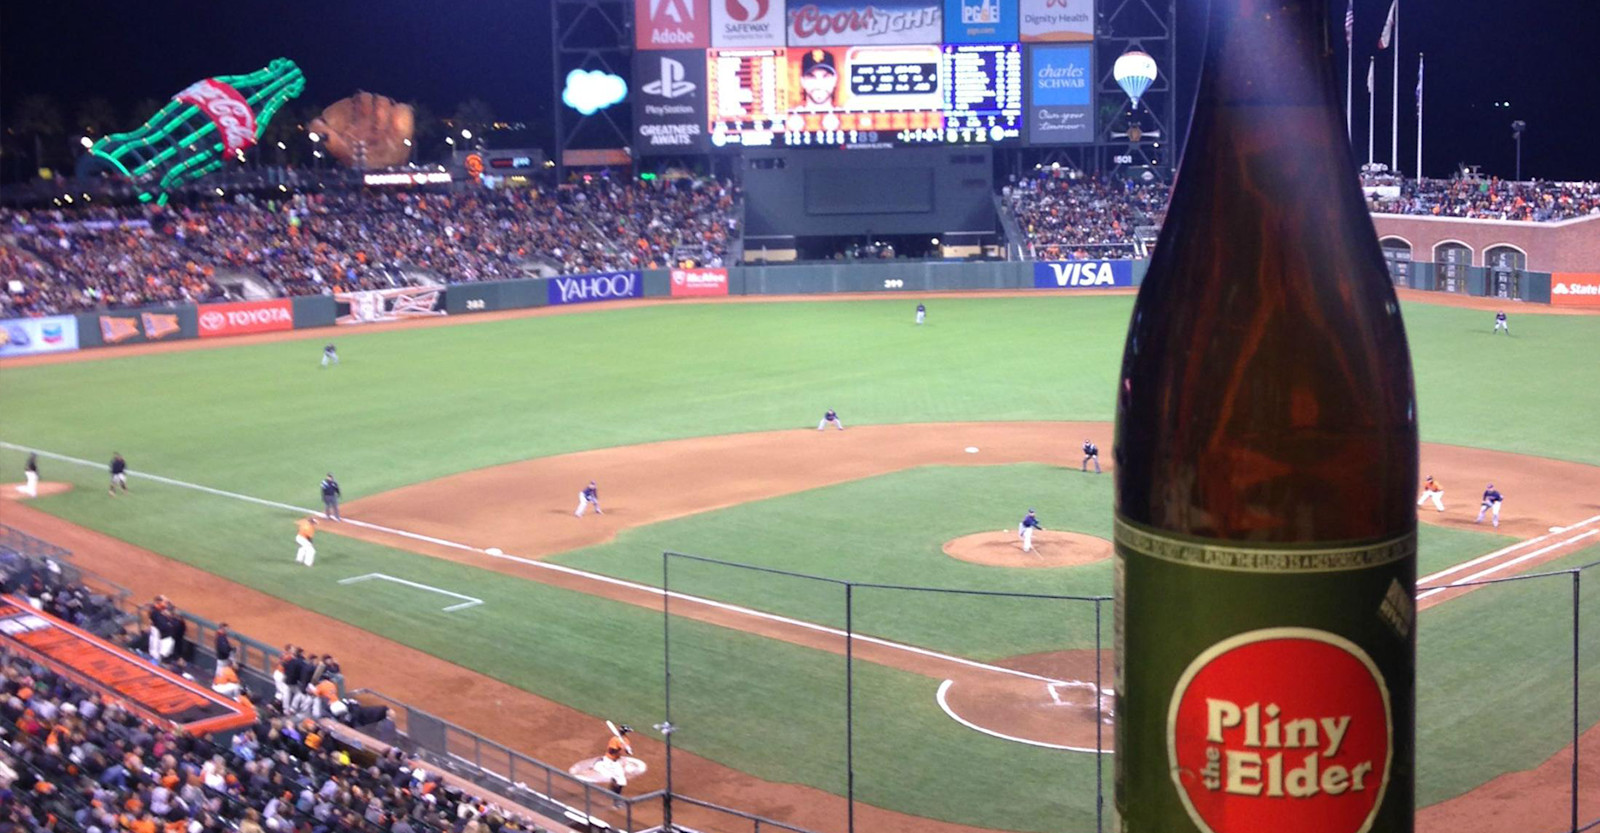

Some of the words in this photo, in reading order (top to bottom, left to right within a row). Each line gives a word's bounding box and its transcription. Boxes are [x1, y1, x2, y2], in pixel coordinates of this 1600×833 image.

[791, 4, 874, 39] Coors
[964, 5, 1000, 22] PG&E
[1024, 13, 1055, 25] Dignity
[1058, 13, 1089, 23] Health
[651, 28, 694, 44] Adobe
[725, 23, 769, 33] SAFEWAY
[1038, 63, 1084, 77] charles
[1038, 78, 1085, 89] SCHWAB
[645, 105, 694, 115] PlayStation
[639, 124, 700, 136] GREATNESS
[1049, 263, 1114, 286] VISA
[556, 274, 634, 301] YAHOO!
[1569, 283, 1597, 295] State
[227, 307, 291, 325] TOYOTA
[1206, 697, 1352, 757] Pliny
[1201, 747, 1220, 789] the
[1225, 749, 1372, 797] Elder
